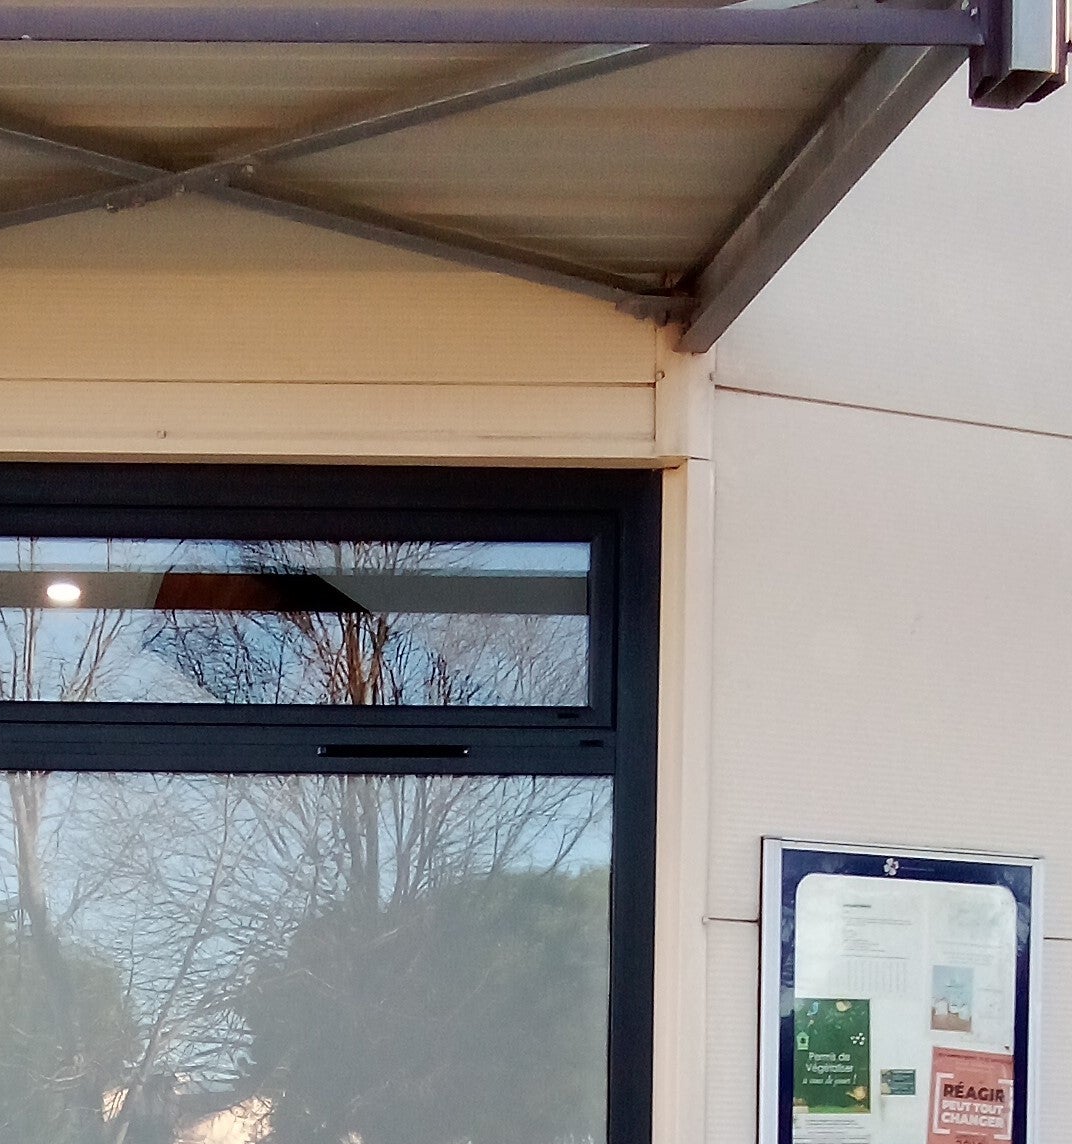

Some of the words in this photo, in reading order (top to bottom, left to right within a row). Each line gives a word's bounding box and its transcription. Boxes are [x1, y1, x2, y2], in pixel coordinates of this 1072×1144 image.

[838, 1052, 851, 1061] de
[943, 1081, 1006, 1103] RÉAGIR
[941, 1100, 971, 1112] PEUT
[972, 1103, 1004, 1115] TOUT
[941, 1113, 1005, 1129] CHANGER
